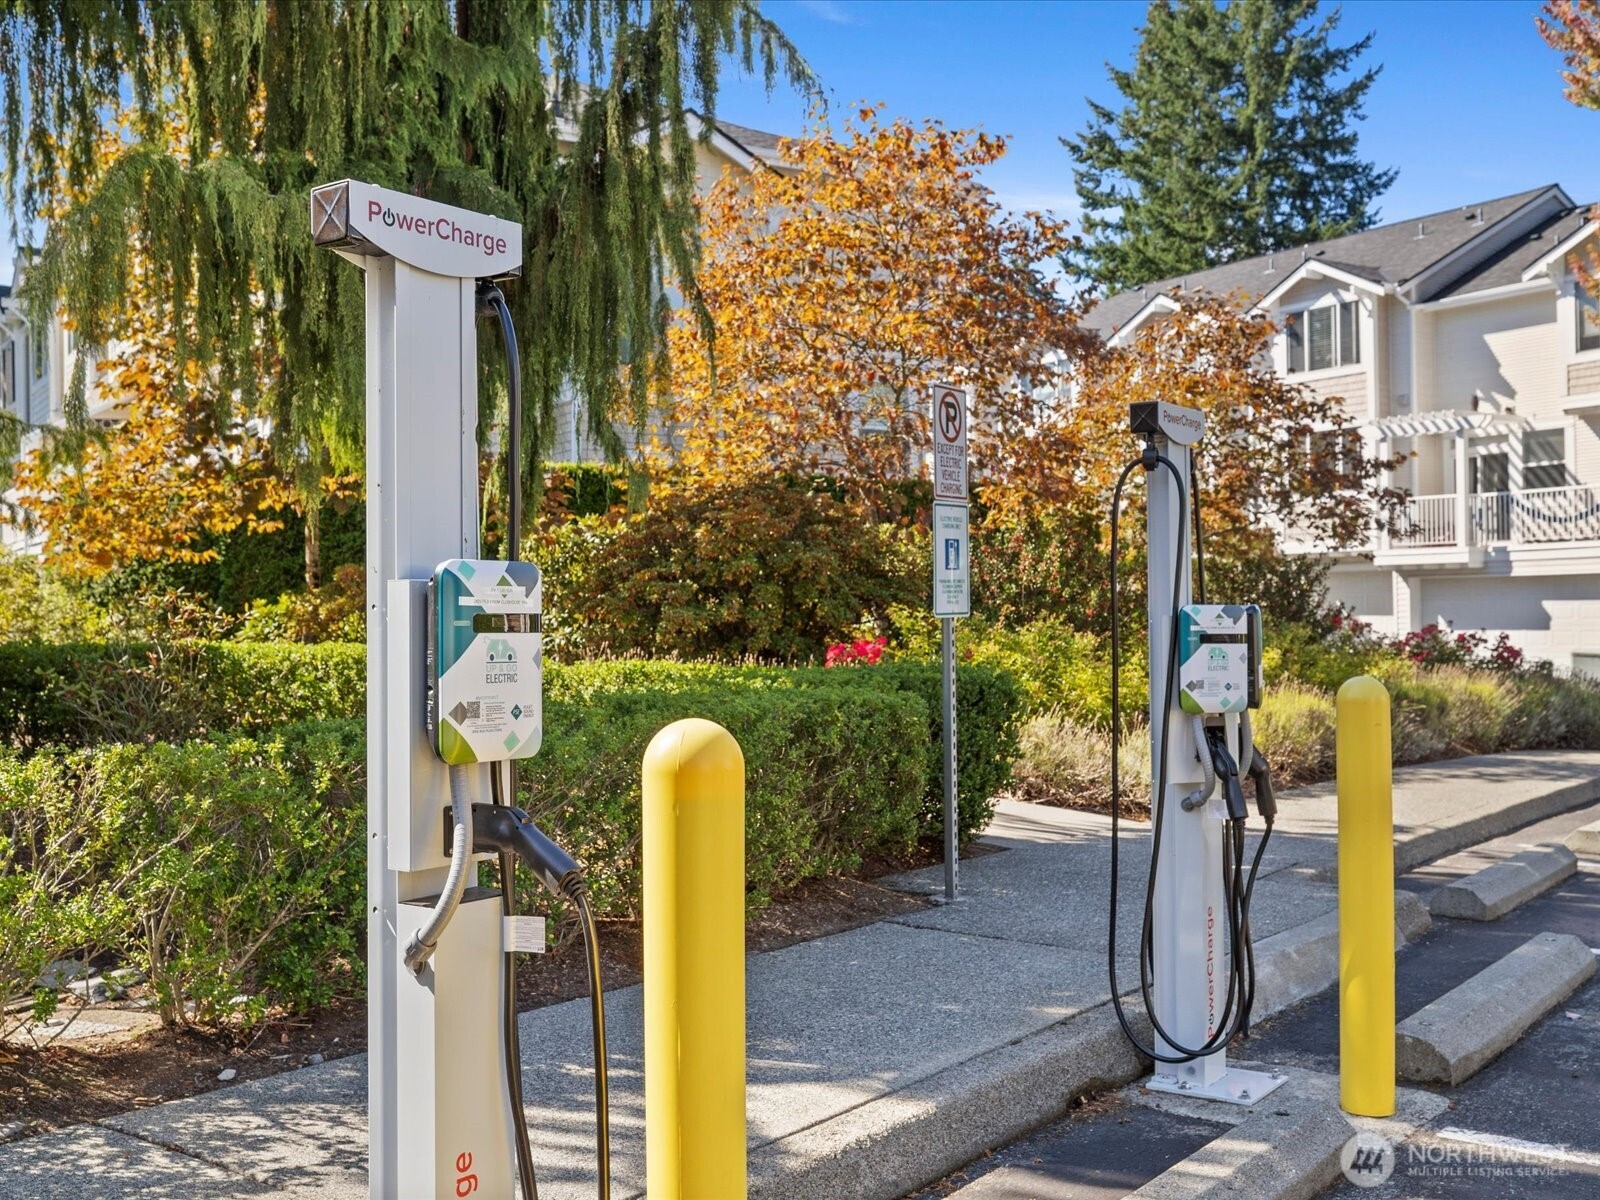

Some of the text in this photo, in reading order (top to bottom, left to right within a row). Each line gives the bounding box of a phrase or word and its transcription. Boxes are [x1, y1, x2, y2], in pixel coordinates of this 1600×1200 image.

[368, 200, 507, 256] PowerCharge
[1163, 409, 1202, 432] PowerCharge
[937, 442, 964, 456] EXCEPT FOR
[940, 456, 962, 469] ELECTRIC
[942, 469, 960, 482] VEHICLE
[940, 482, 963, 495] CHARGING
[486, 664, 518, 672] UP & GO
[486, 673, 518, 684] ELECTRIC
[1206, 906, 1215, 1038] PowerCharge
